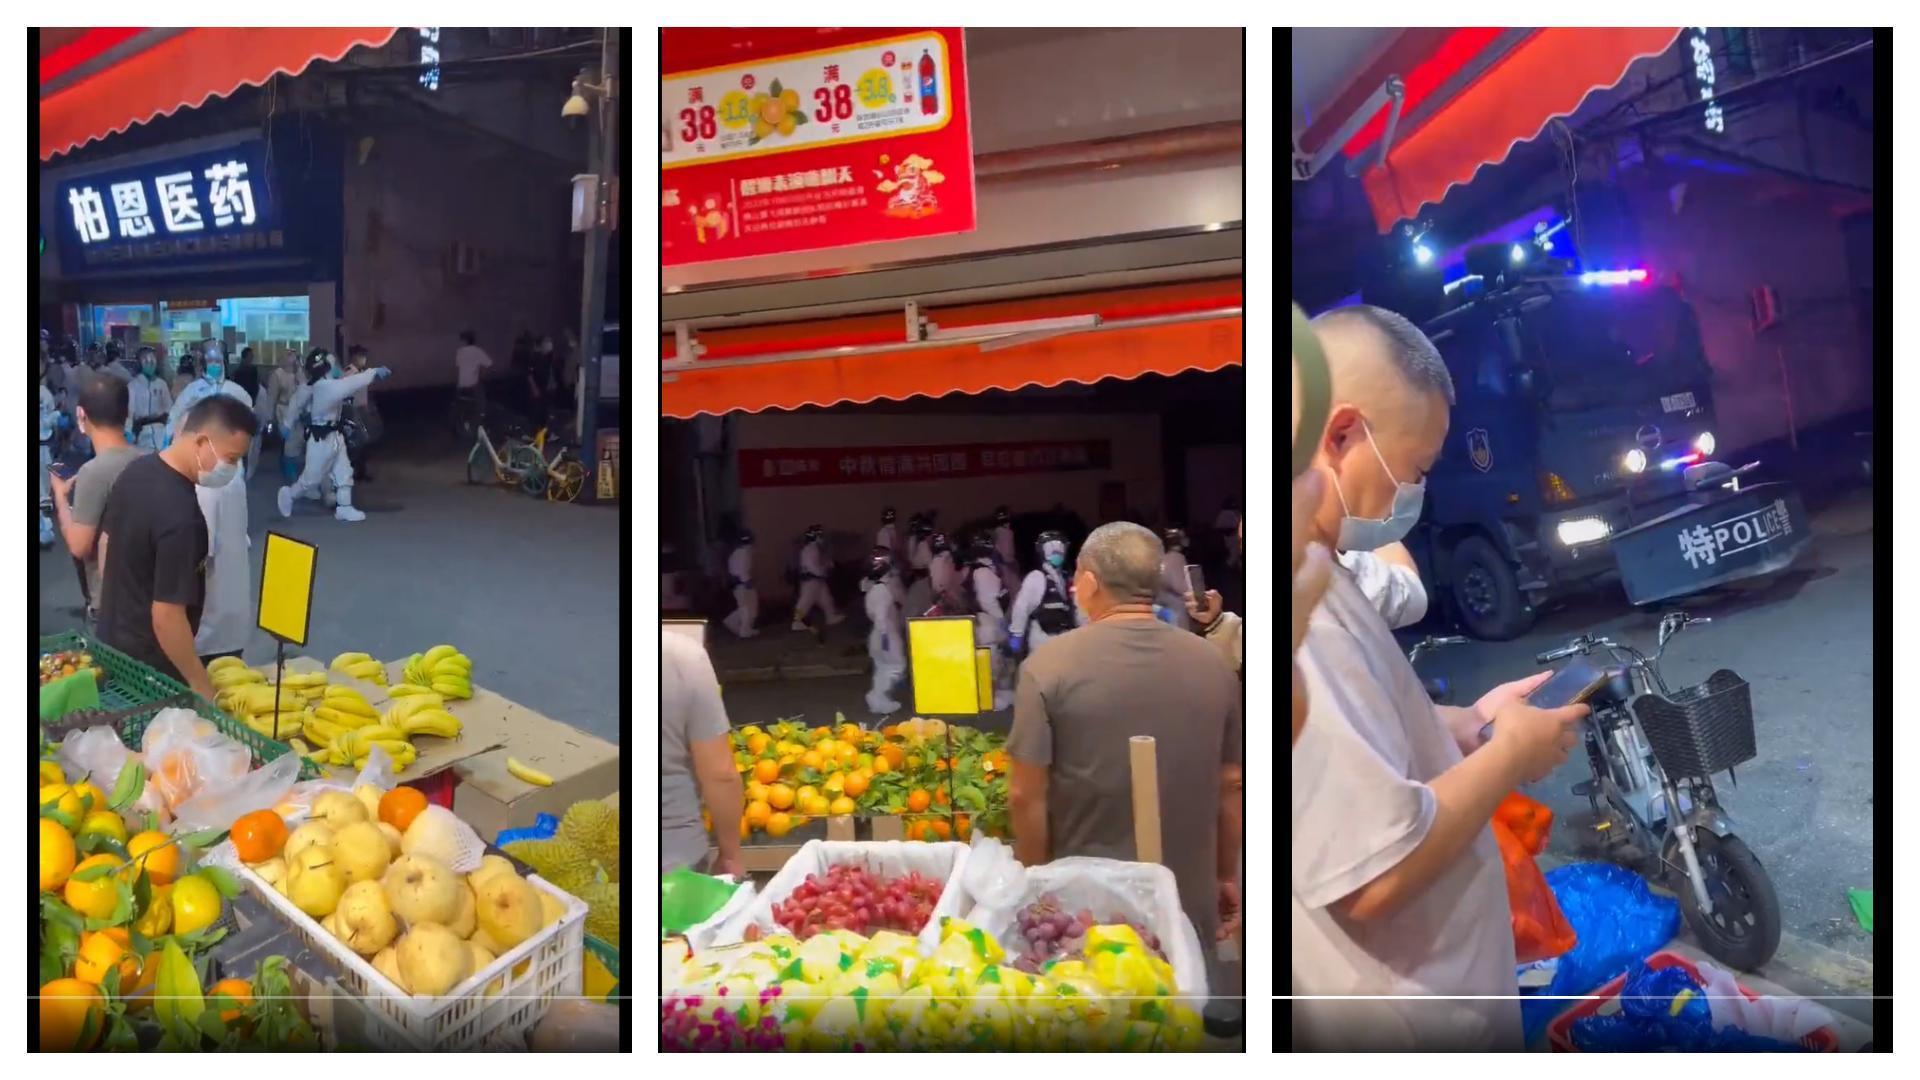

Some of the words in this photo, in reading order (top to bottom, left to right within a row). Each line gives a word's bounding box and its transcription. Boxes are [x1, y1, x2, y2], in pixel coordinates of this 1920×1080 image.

[680, 105, 717, 143] 38
[814, 84, 853, 123] 38
[69, 160, 256, 243] 柏恩医药
[1678, 524, 1716, 569] 特
[1714, 510, 1782, 551] POLICE
